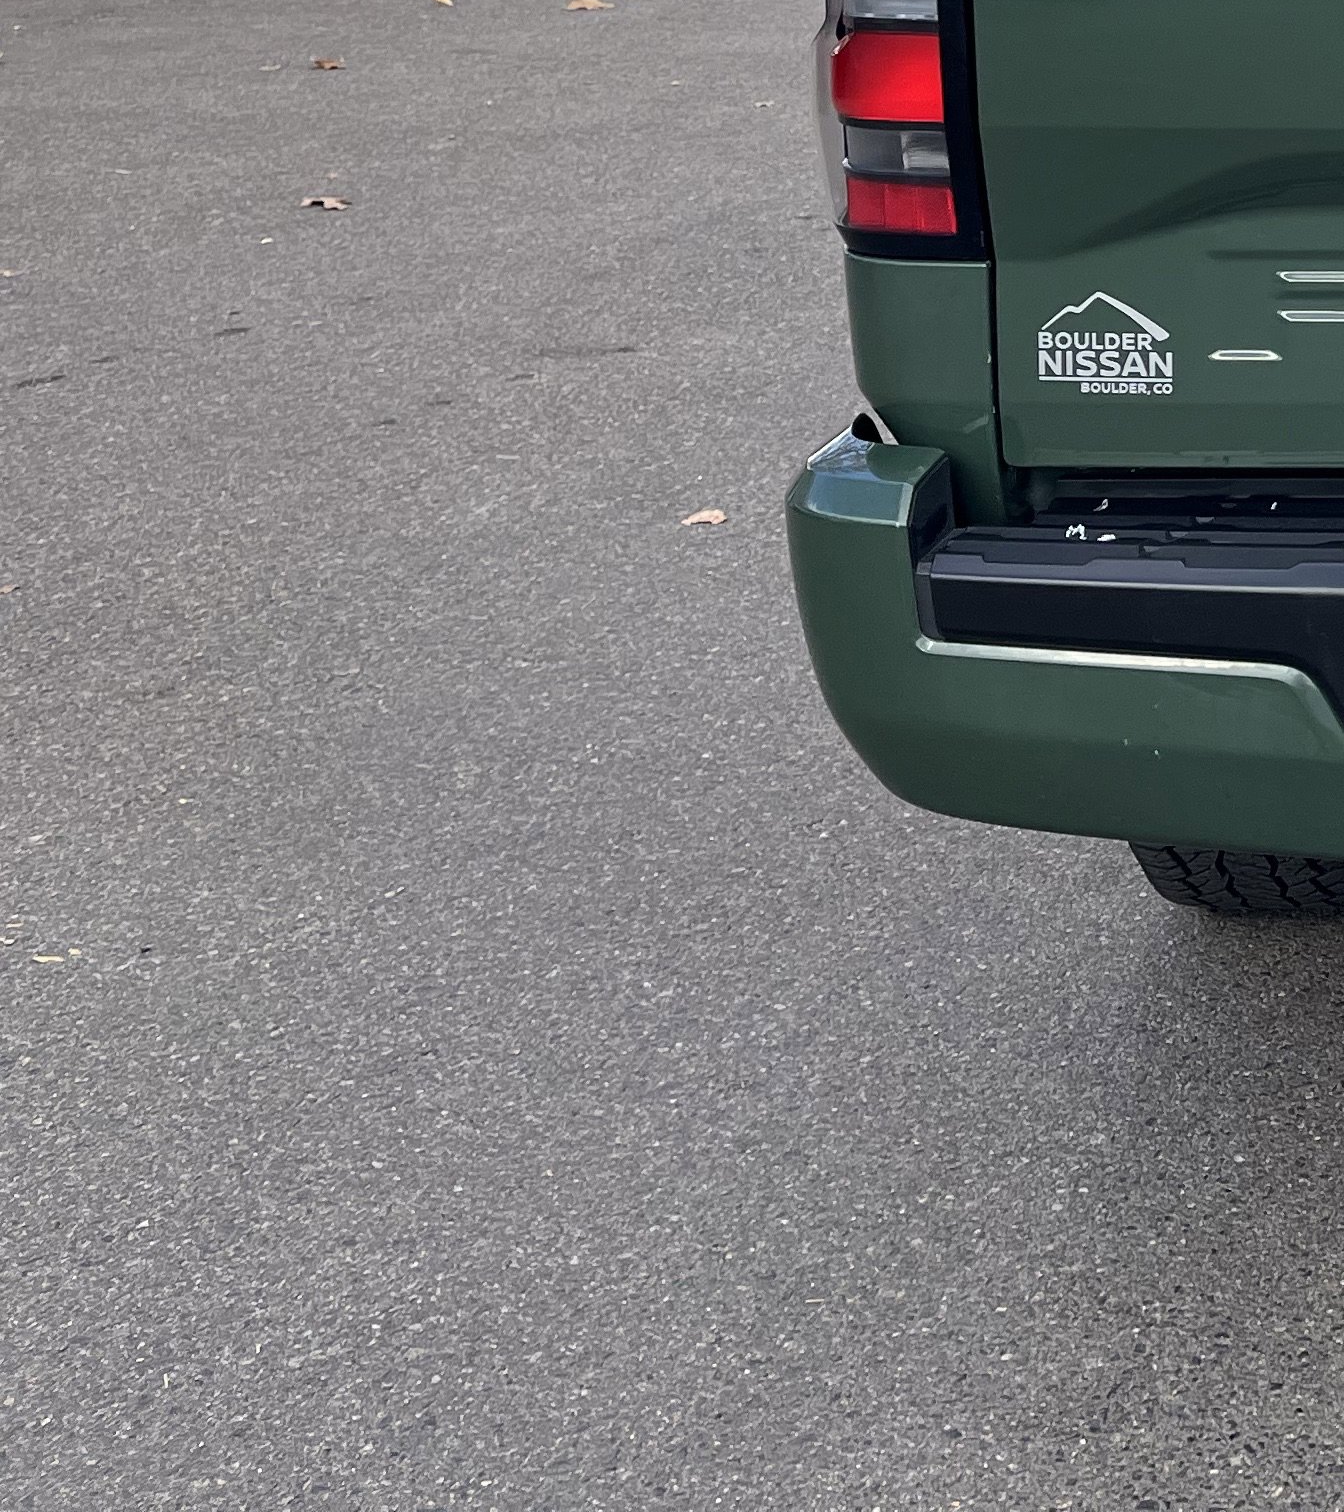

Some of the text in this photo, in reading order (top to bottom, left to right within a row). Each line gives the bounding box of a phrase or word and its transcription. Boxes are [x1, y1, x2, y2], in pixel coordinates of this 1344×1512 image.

[1037, 331, 1153, 351] BOULDER
[1038, 350, 1173, 377] NISSAN
[1080, 383, 1173, 395] BOULDER, CO
